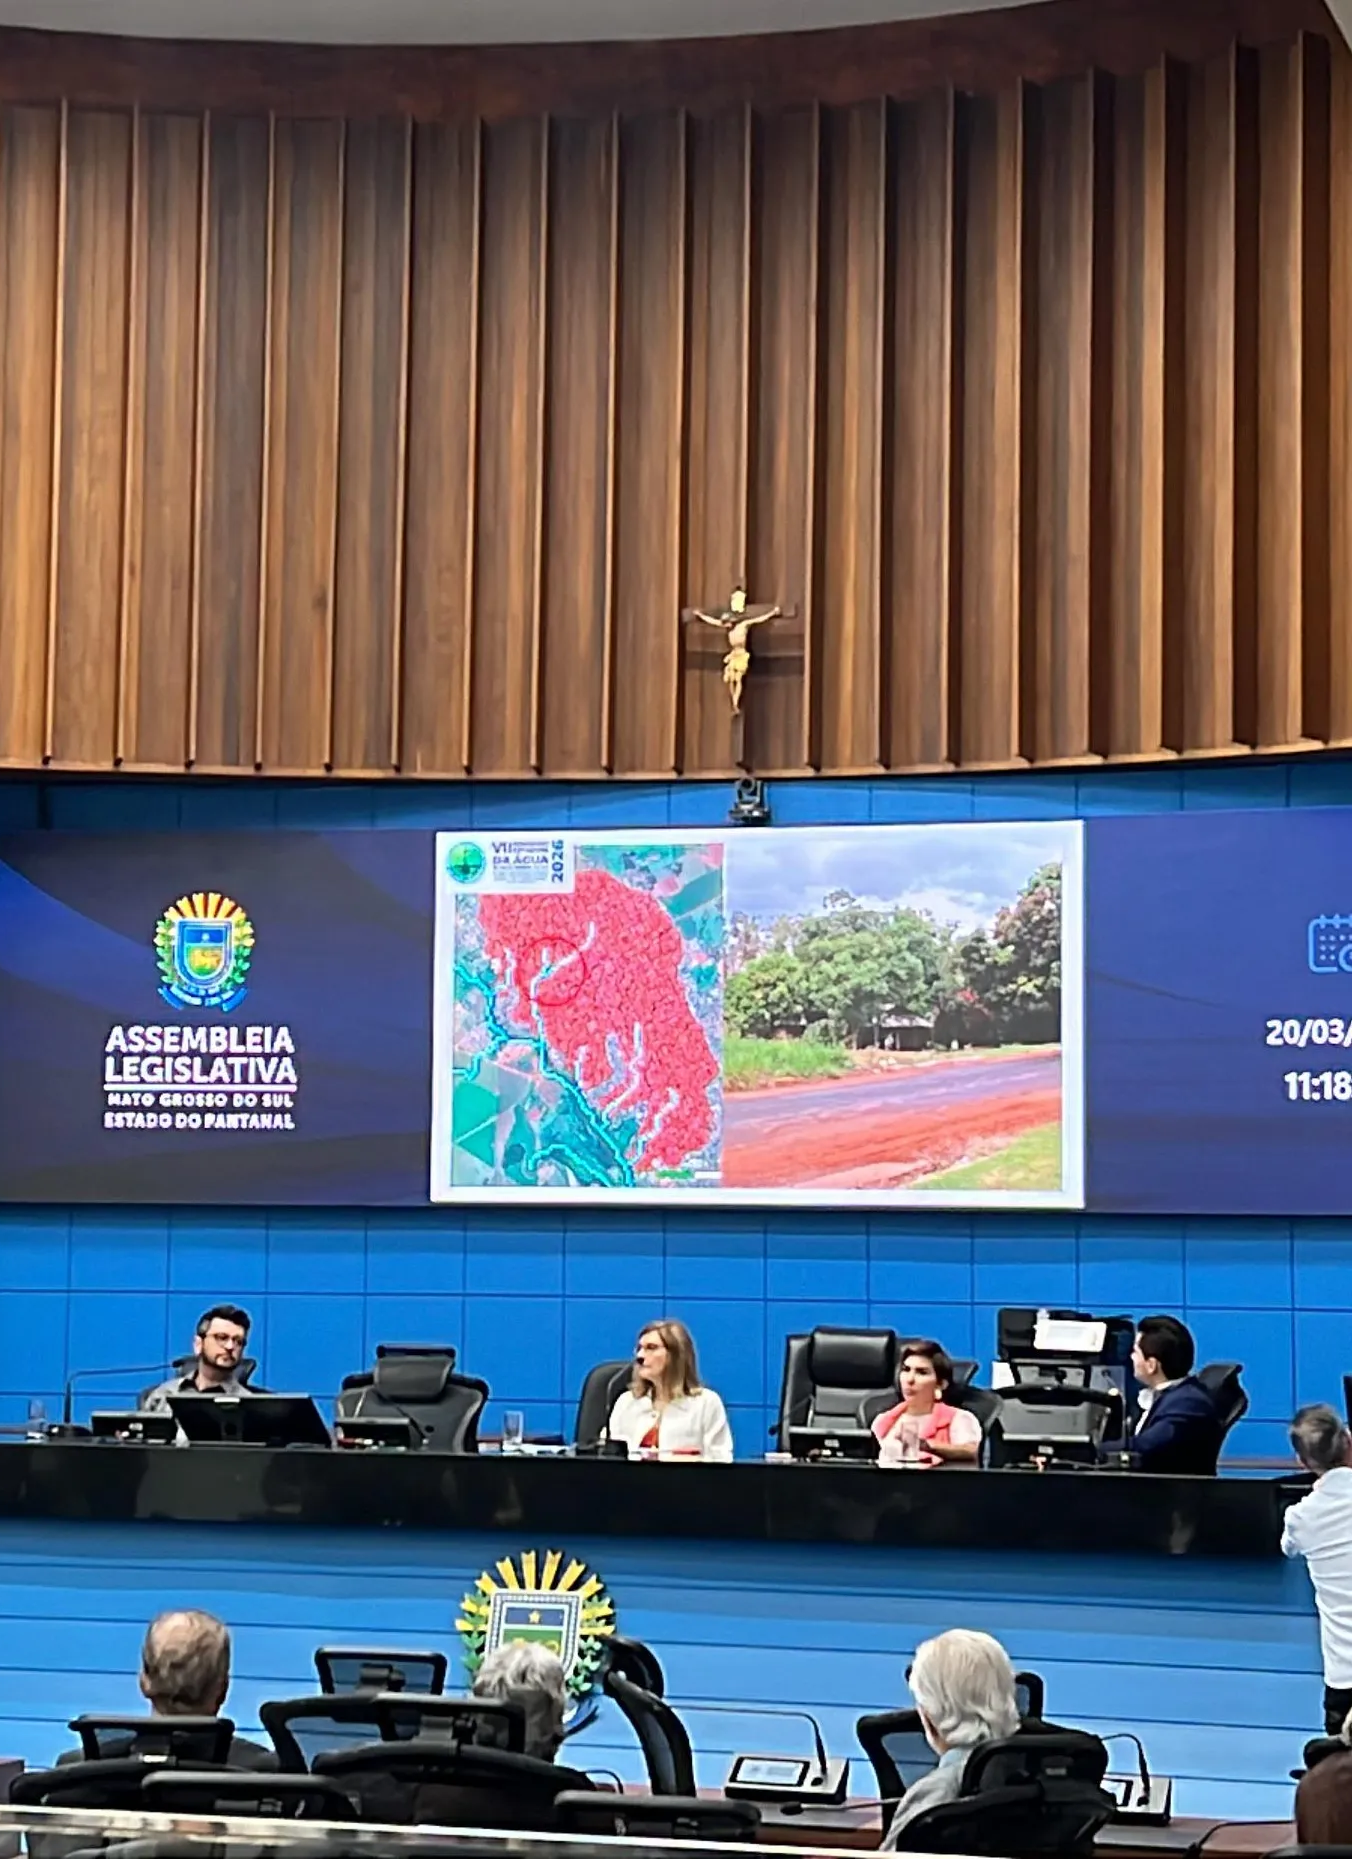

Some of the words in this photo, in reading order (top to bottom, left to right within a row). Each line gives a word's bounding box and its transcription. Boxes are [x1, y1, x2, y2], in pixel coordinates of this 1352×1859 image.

[551, 839, 564, 883] 2026
[105, 1026, 295, 1053] ASSEMBLEIA
[105, 1056, 297, 1083] LEGISLATIVA
[1284, 1071, 1352, 1100] 11:18
[108, 1093, 155, 1107] MATO
[159, 1093, 228, 1107] GROSSO
[232, 1093, 257, 1107] DO
[261, 1093, 294, 1107] SUL
[104, 1112, 172, 1128] ESTADO
[175, 1112, 202, 1128] DO
[204, 1112, 295, 1129] PANTANAL
